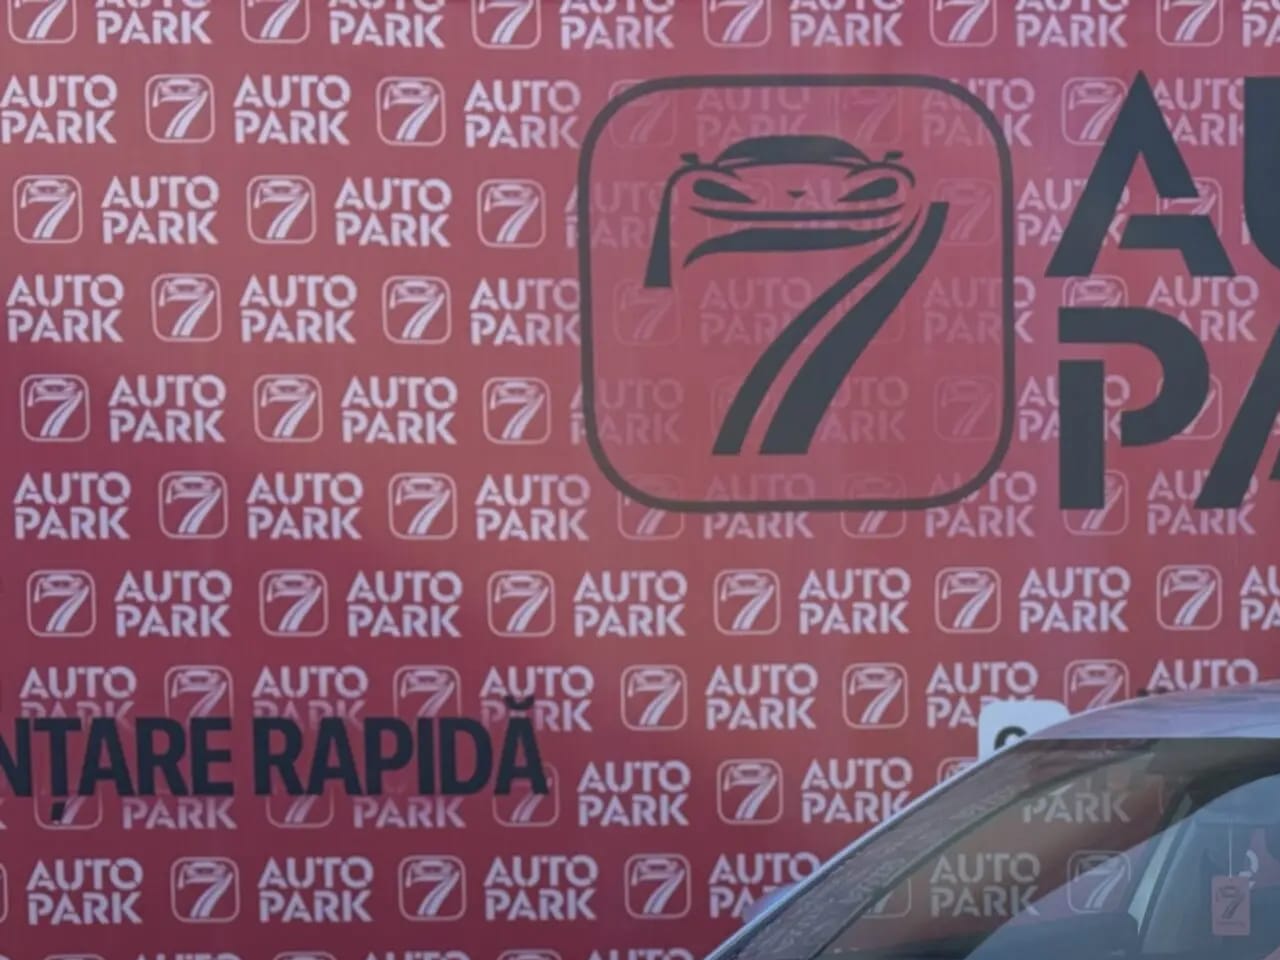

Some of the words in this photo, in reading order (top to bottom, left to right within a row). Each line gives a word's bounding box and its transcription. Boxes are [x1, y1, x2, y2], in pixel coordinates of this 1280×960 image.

[98, 11, 211, 43] PARK
[330, 13, 443, 47] PARK
[561, 15, 672, 49] PARK
[791, 13, 901, 46] PARK
[1017, 14, 1126, 47] PARK
[0, 75, 117, 108] AUTO
[234, 75, 350, 109] AUTO
[464, 80, 580, 114] AUTO
[2, 111, 116, 143] PARK
[236, 110, 349, 144] PARK
[466, 114, 578, 148] PARK
[102, 176, 218, 210] AUTO
[335, 178, 451, 212] AUTO
[103, 211, 217, 244] PARK
[336, 212, 449, 246] PARK
[7, 275, 123, 308] AUTO
[240, 275, 356, 309] AUTO
[470, 278, 579, 311] AUTO
[1146, 275, 1259, 308] AUTO
[8, 310, 122, 342] PARK
[242, 310, 355, 342] PARK
[471, 312, 580, 345] PARK
[109, 375, 225, 408] AUTO
[342, 377, 457, 410] AUTO
[110, 410, 224, 442] PARK
[343, 411, 456, 444] PARK
[14, 472, 130, 506] AUTO
[247, 473, 363, 506] AUTO
[475, 475, 589, 507] AUTO
[16, 507, 128, 539] PARK
[248, 507, 361, 539] PARK
[477, 508, 587, 540] PARK
[925, 505, 1033, 537] PARK
[1148, 503, 1255, 534] PARK
[115, 571, 232, 604] AUTO
[347, 571, 462, 604] AUTO
[574, 571, 687, 604] AUTO
[799, 568, 910, 601] AUTO
[1019, 567, 1130, 599] AUTO
[117, 605, 229, 636] PARK
[348, 605, 460, 637] PARK
[575, 605, 684, 636] PARK
[800, 602, 908, 634] PARK
[1020, 600, 1128, 632] PARK
[20, 667, 136, 700] AUTO
[253, 666, 368, 699] AUTO
[480, 666, 594, 699] AUTO
[706, 664, 817, 697] AUTO
[926, 662, 1038, 694] AUTO
[707, 698, 815, 729] PARK
[253, 695, 549, 795] RAPIDĂ
[578, 761, 690, 794] AUTO
[802, 758, 912, 790] AUTO
[123, 798, 236, 829] PARK
[354, 797, 465, 828] PARK
[579, 794, 688, 826] PARK
[27, 858, 143, 892] AUTO
[258, 857, 373, 890] AUTO
[484, 855, 597, 888] AUTO
[710, 852, 820, 886] AUTO
[931, 851, 1040, 884] AUTO
[29, 892, 141, 924] PARK
[260, 890, 371, 922] PARK
[486, 889, 595, 920] PARK
